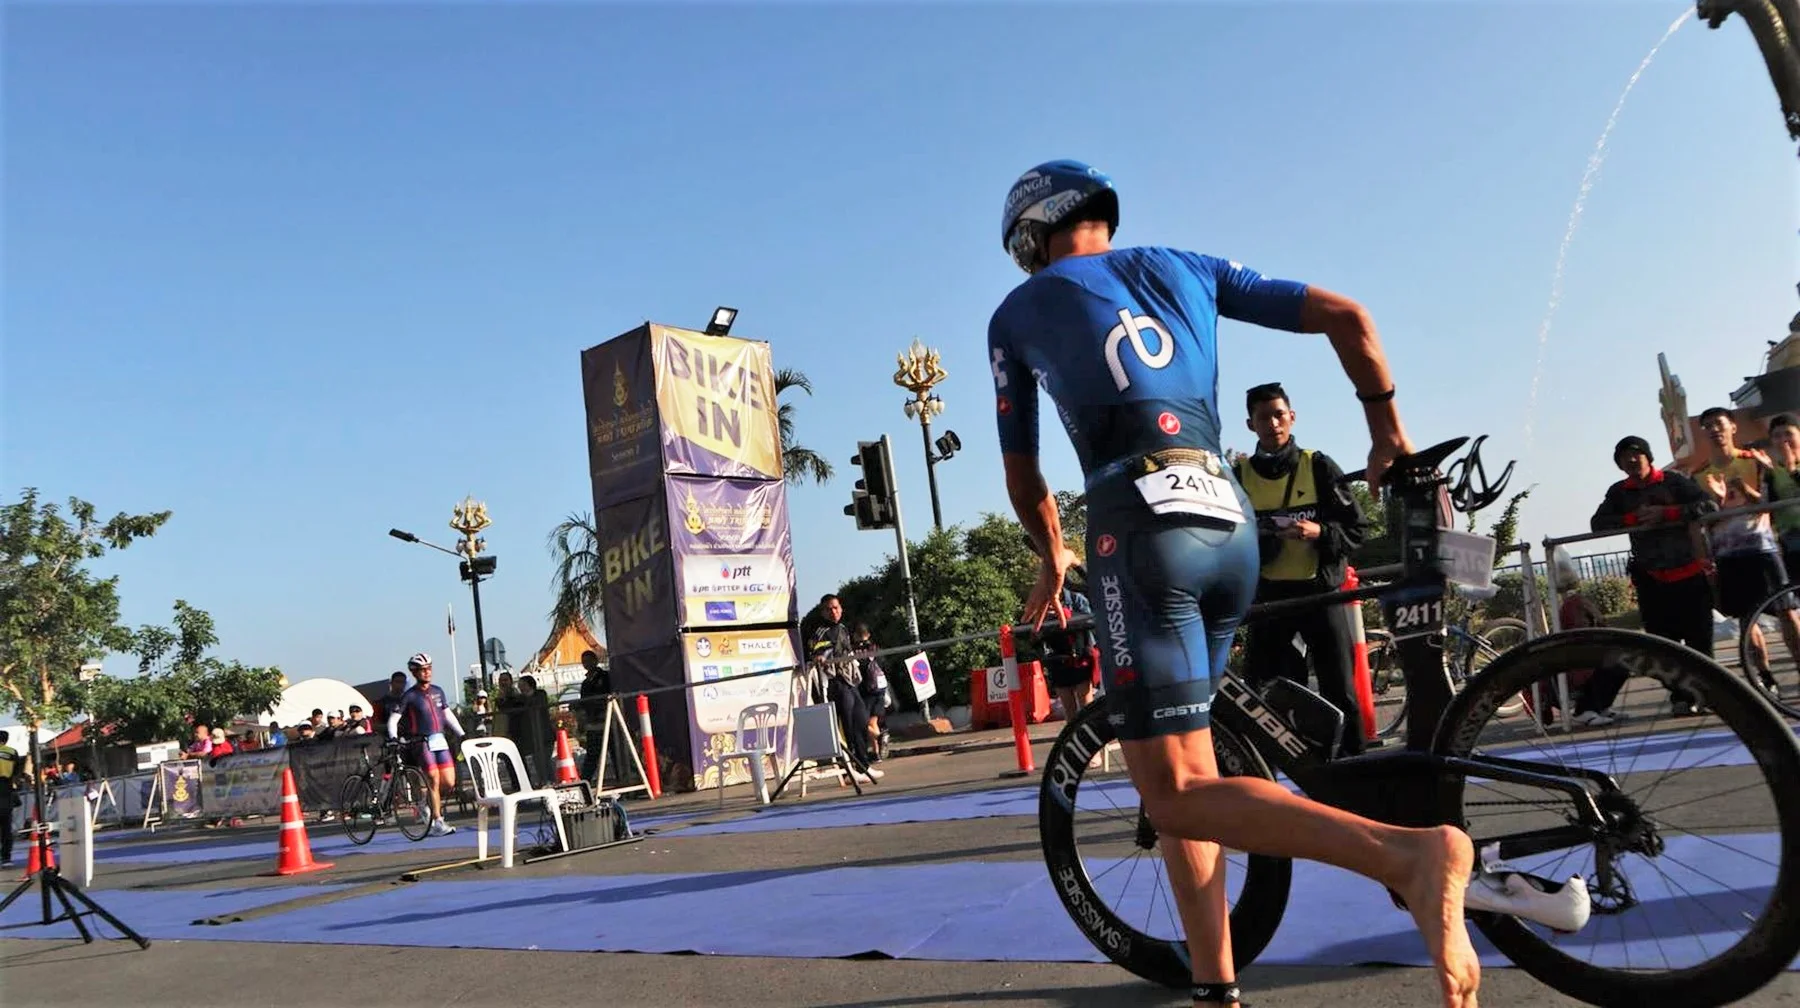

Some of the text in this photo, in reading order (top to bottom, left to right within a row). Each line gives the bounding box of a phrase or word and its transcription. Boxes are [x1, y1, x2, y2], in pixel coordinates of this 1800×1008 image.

[666, 336, 763, 410] BIKE
[697, 395, 741, 448] IN
[1165, 473, 1218, 497] 2411
[604, 516, 664, 584] BIKE
[732, 565, 752, 579] ptt
[625, 568, 653, 616] IN
[1395, 600, 1443, 628] 2411
[1218, 676, 1308, 759] CUBE
